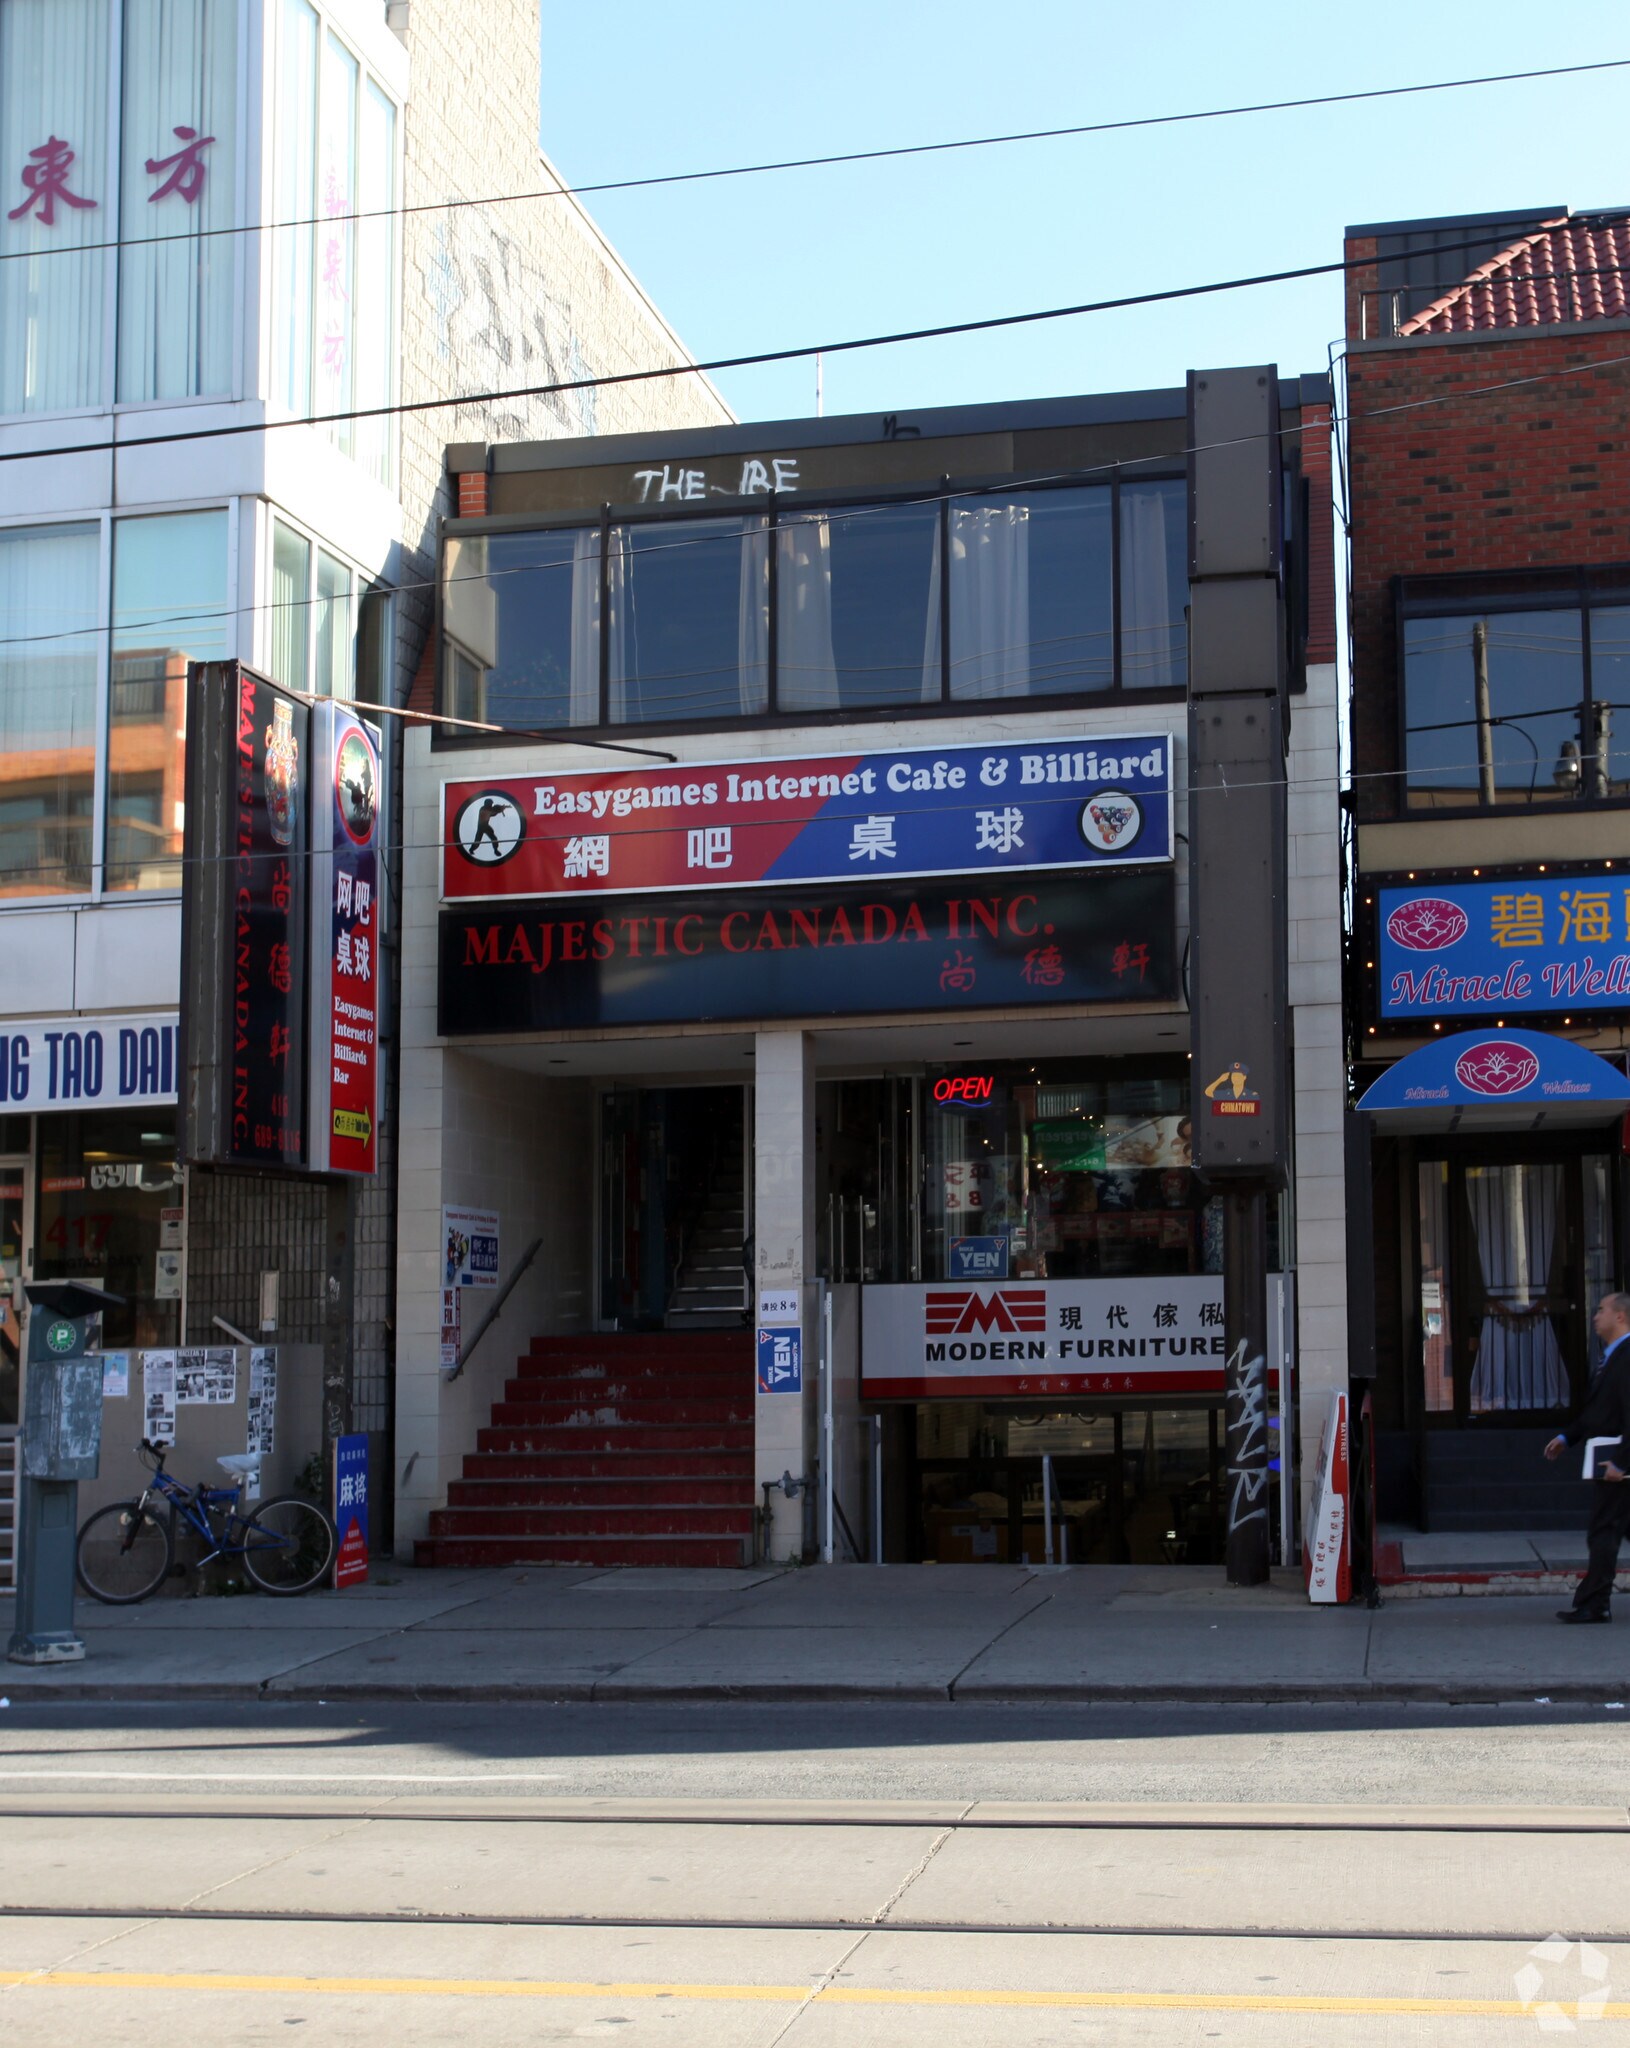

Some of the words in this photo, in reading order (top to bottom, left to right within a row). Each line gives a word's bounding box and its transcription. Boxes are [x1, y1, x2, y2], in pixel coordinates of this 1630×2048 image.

[8, 126, 216, 225] 東方
[634, 464, 706, 503] THE
[236, 676, 257, 876] MAJESTIC
[533, 783, 719, 818] Easygames
[726, 767, 877, 804] Internet
[886, 760, 967, 793] Cafe
[979, 756, 1009, 787] &
[1020, 747, 1165, 785] Billiard
[563, 826, 734, 879] 網吧
[848, 806, 1025, 861] 桌球
[336, 870, 371, 926] 网吧
[1490, 888, 1630, 949] 碧海
[336, 928, 372, 983] 桌球
[462, 914, 705, 974] MAJESTIC
[719, 901, 932, 953] CANADA
[945, 895, 1056, 940] INC.
[236, 888, 252, 1052] CANADA
[1388, 959, 1532, 1006] Miracle
[1541, 954, 1630, 999] Well
[333, 995, 374, 1021] Easygames
[333, 1019, 367, 1043] Internet
[44, 1030, 104, 1100] TAO
[118, 1024, 180, 1096] DAI
[333, 1043, 367, 1067] Billiards
[333, 1066, 350, 1085] Bar
[234, 1065, 249, 1150] INC.
[933, 1076, 994, 1101] OPEN
[1220, 1101, 1256, 1114] CHINATOWN
[1404, 1085, 1450, 1100] Miracle
[1541, 1079, 1592, 1095] Wellness
[46, 1215, 113, 1249] 417
[960, 1252, 1000, 1268] YEN
[773, 1336, 791, 1383] YEN
[925, 1340, 1046, 1362] MODERN
[1059, 1336, 1225, 1359] FURNITURE
[339, 1472, 367, 1507] 麻将
